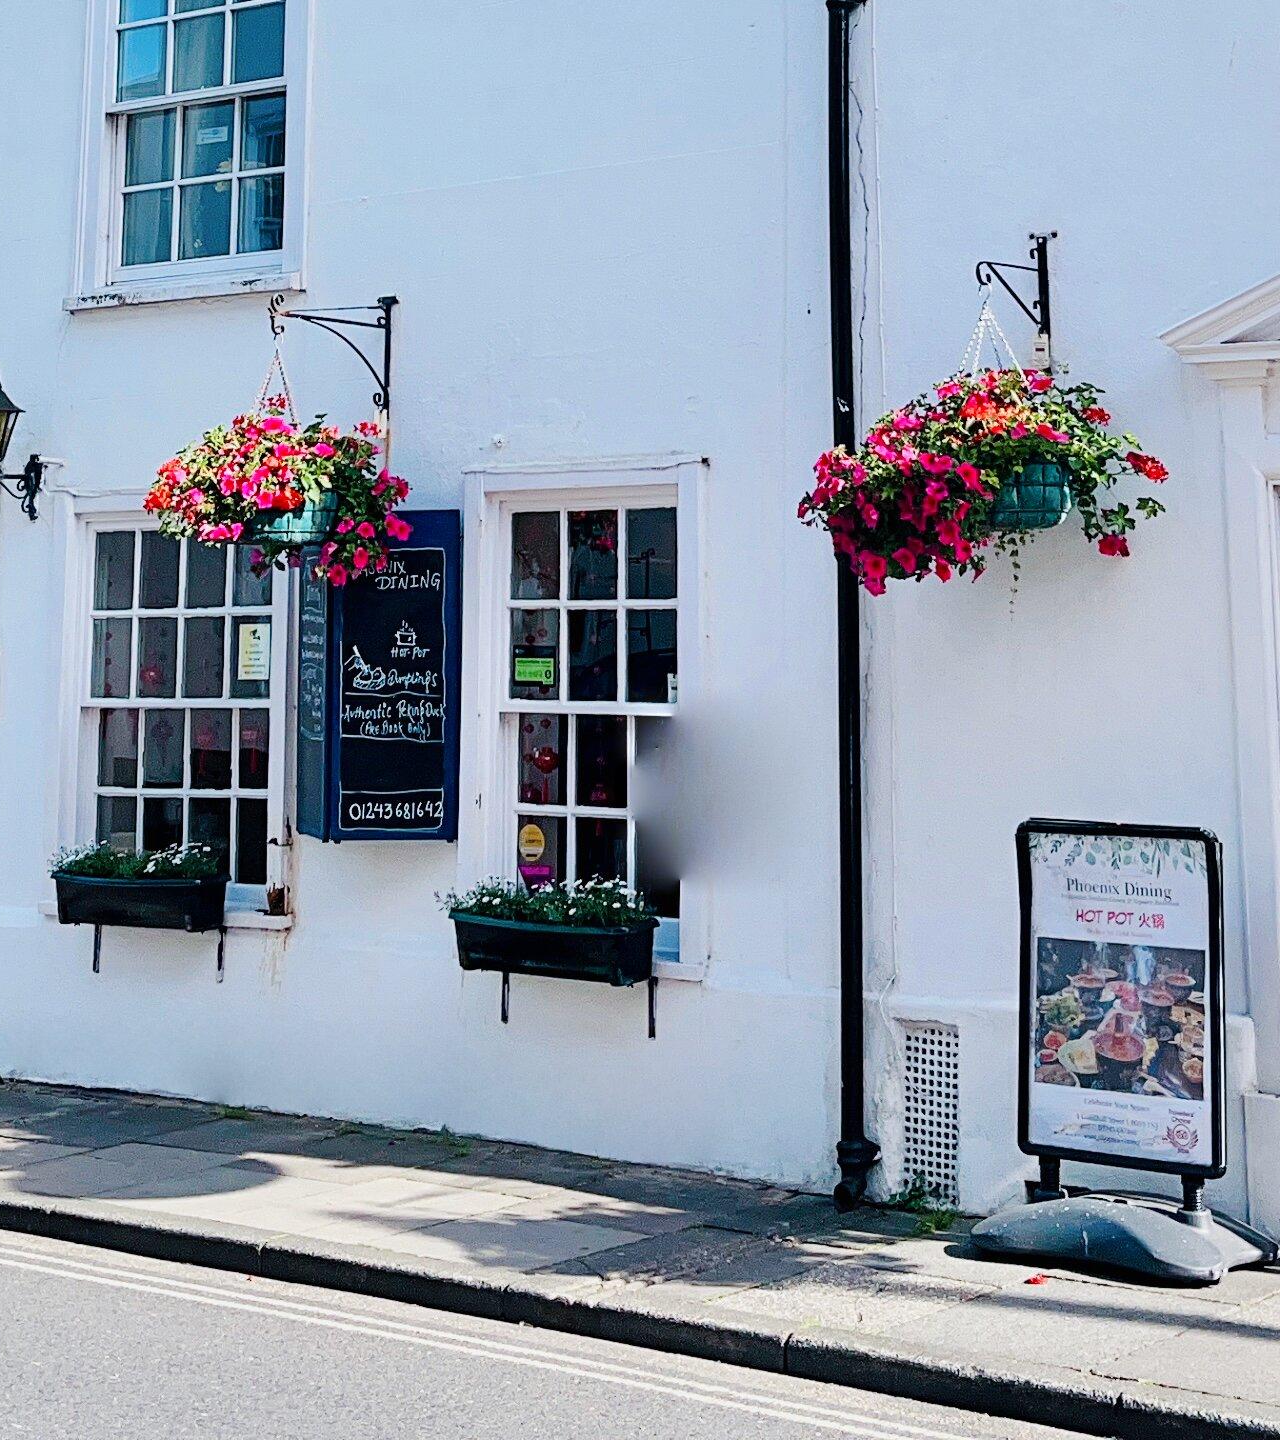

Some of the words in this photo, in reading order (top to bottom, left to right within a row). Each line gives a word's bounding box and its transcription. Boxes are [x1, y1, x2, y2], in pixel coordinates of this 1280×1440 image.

[375, 570, 440, 591] DINING
[342, 702, 392, 722] Authentic
[1066, 877, 1120, 895] Phoenix
[1125, 881, 1172, 901] Dining
[1076, 909, 1103, 923] HOT
[1107, 911, 1134, 926] POT
